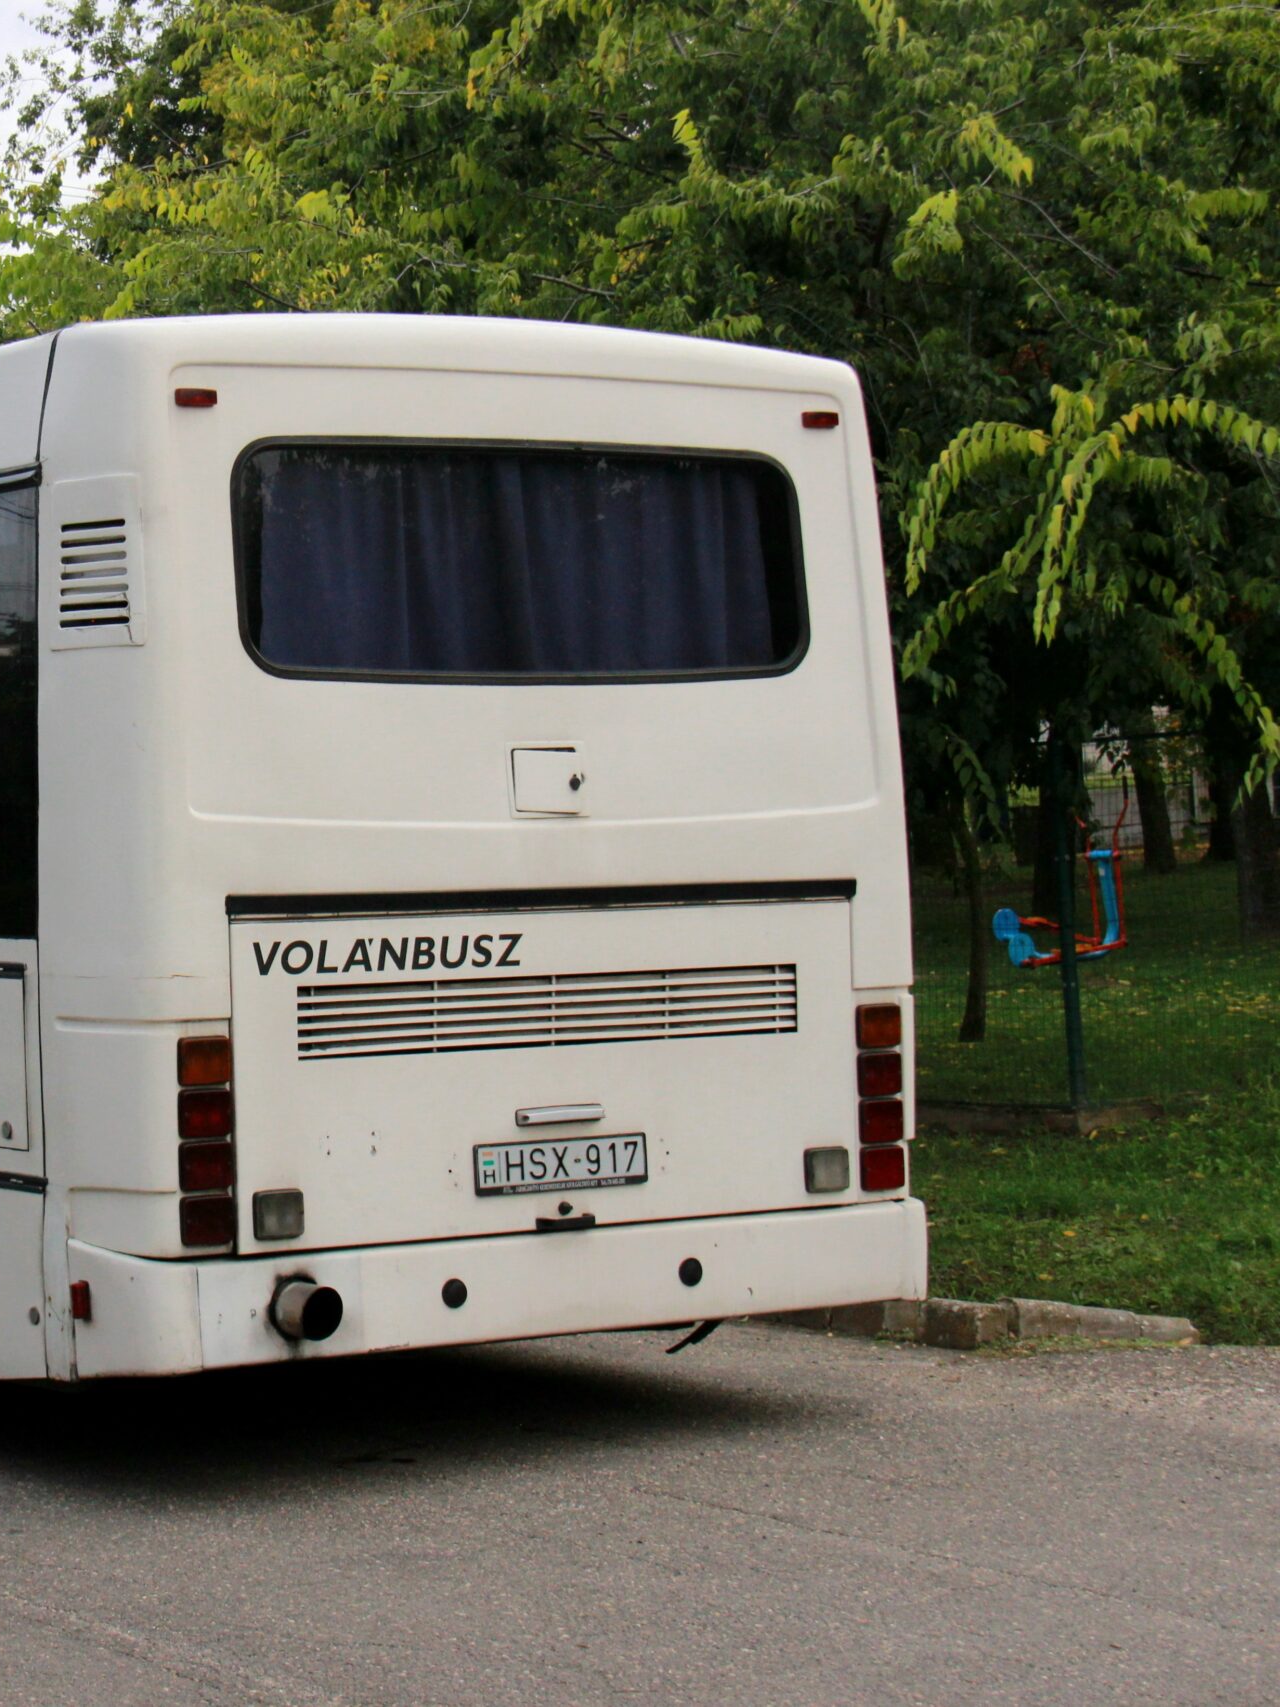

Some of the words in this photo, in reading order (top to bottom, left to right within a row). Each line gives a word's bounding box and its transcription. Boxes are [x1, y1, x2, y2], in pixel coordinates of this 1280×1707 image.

[252, 933, 524, 976] VOLÁNBUSZ
[483, 1169, 496, 1184] H
[505, 1140, 638, 1182] HSX-917
